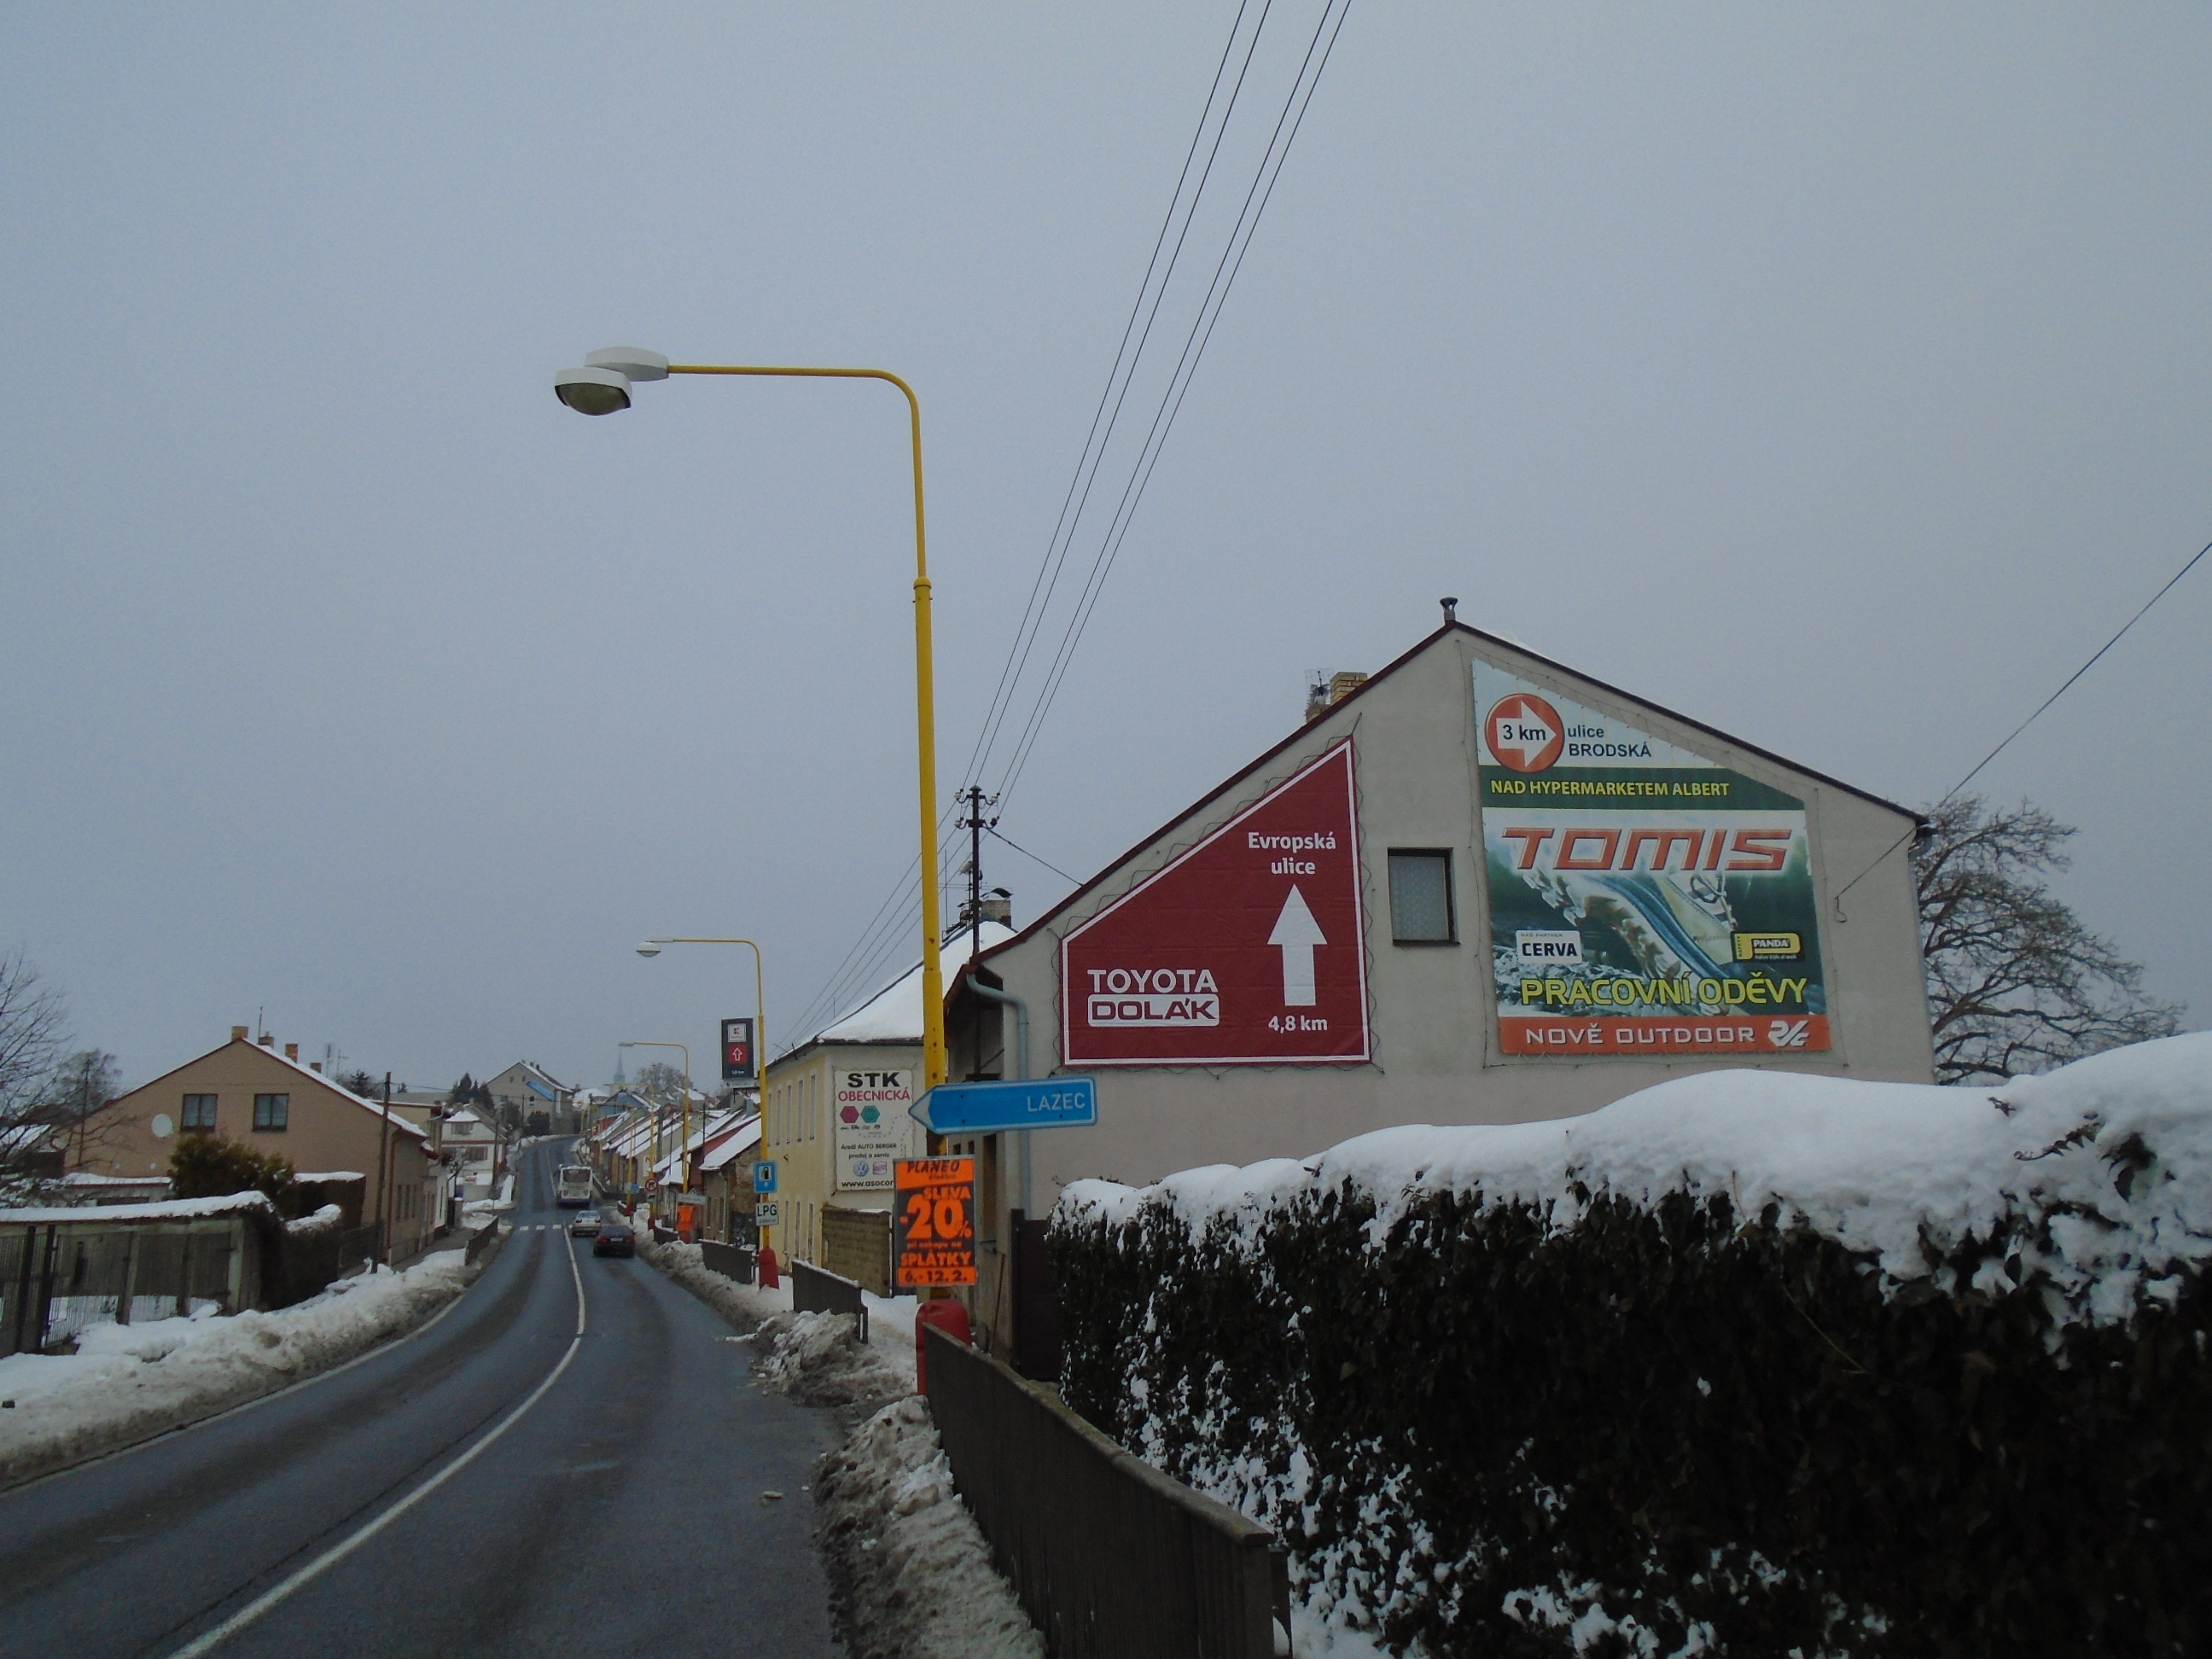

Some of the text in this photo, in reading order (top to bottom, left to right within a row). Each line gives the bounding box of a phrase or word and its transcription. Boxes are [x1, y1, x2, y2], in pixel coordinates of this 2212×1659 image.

[1503, 725, 1546, 741] 3 km
[1568, 725, 1604, 738] ulice
[1569, 742, 1651, 758] BRODSKÁ
[1491, 780, 1729, 797] NAD HYPERMARKETEM ALBERT
[1249, 831, 1336, 853] Evropská
[1502, 828, 1792, 870] TOMIS
[1271, 857, 1315, 875] ulice
[1522, 943, 1577, 957] CERVA
[1087, 969, 1219, 993] TOYOTA
[1521, 971, 1807, 1005] PRACOVNÍ ODĚVY
[1091, 997, 1216, 1021] DOLÁK
[1268, 1016, 1328, 1033] 4,8 km
[1526, 1023, 1755, 1045] NOVĚ OUTDOOR
[847, 1072, 900, 1088] STK
[838, 1086, 911, 1102] OBECNICKÁ
[1027, 1092, 1086, 1112] LAZEC
[923, 1186, 971, 1199] SLEVA
[757, 1204, 777, 1217] LPG
[899, 1249, 972, 1266] SPLÁTKY
